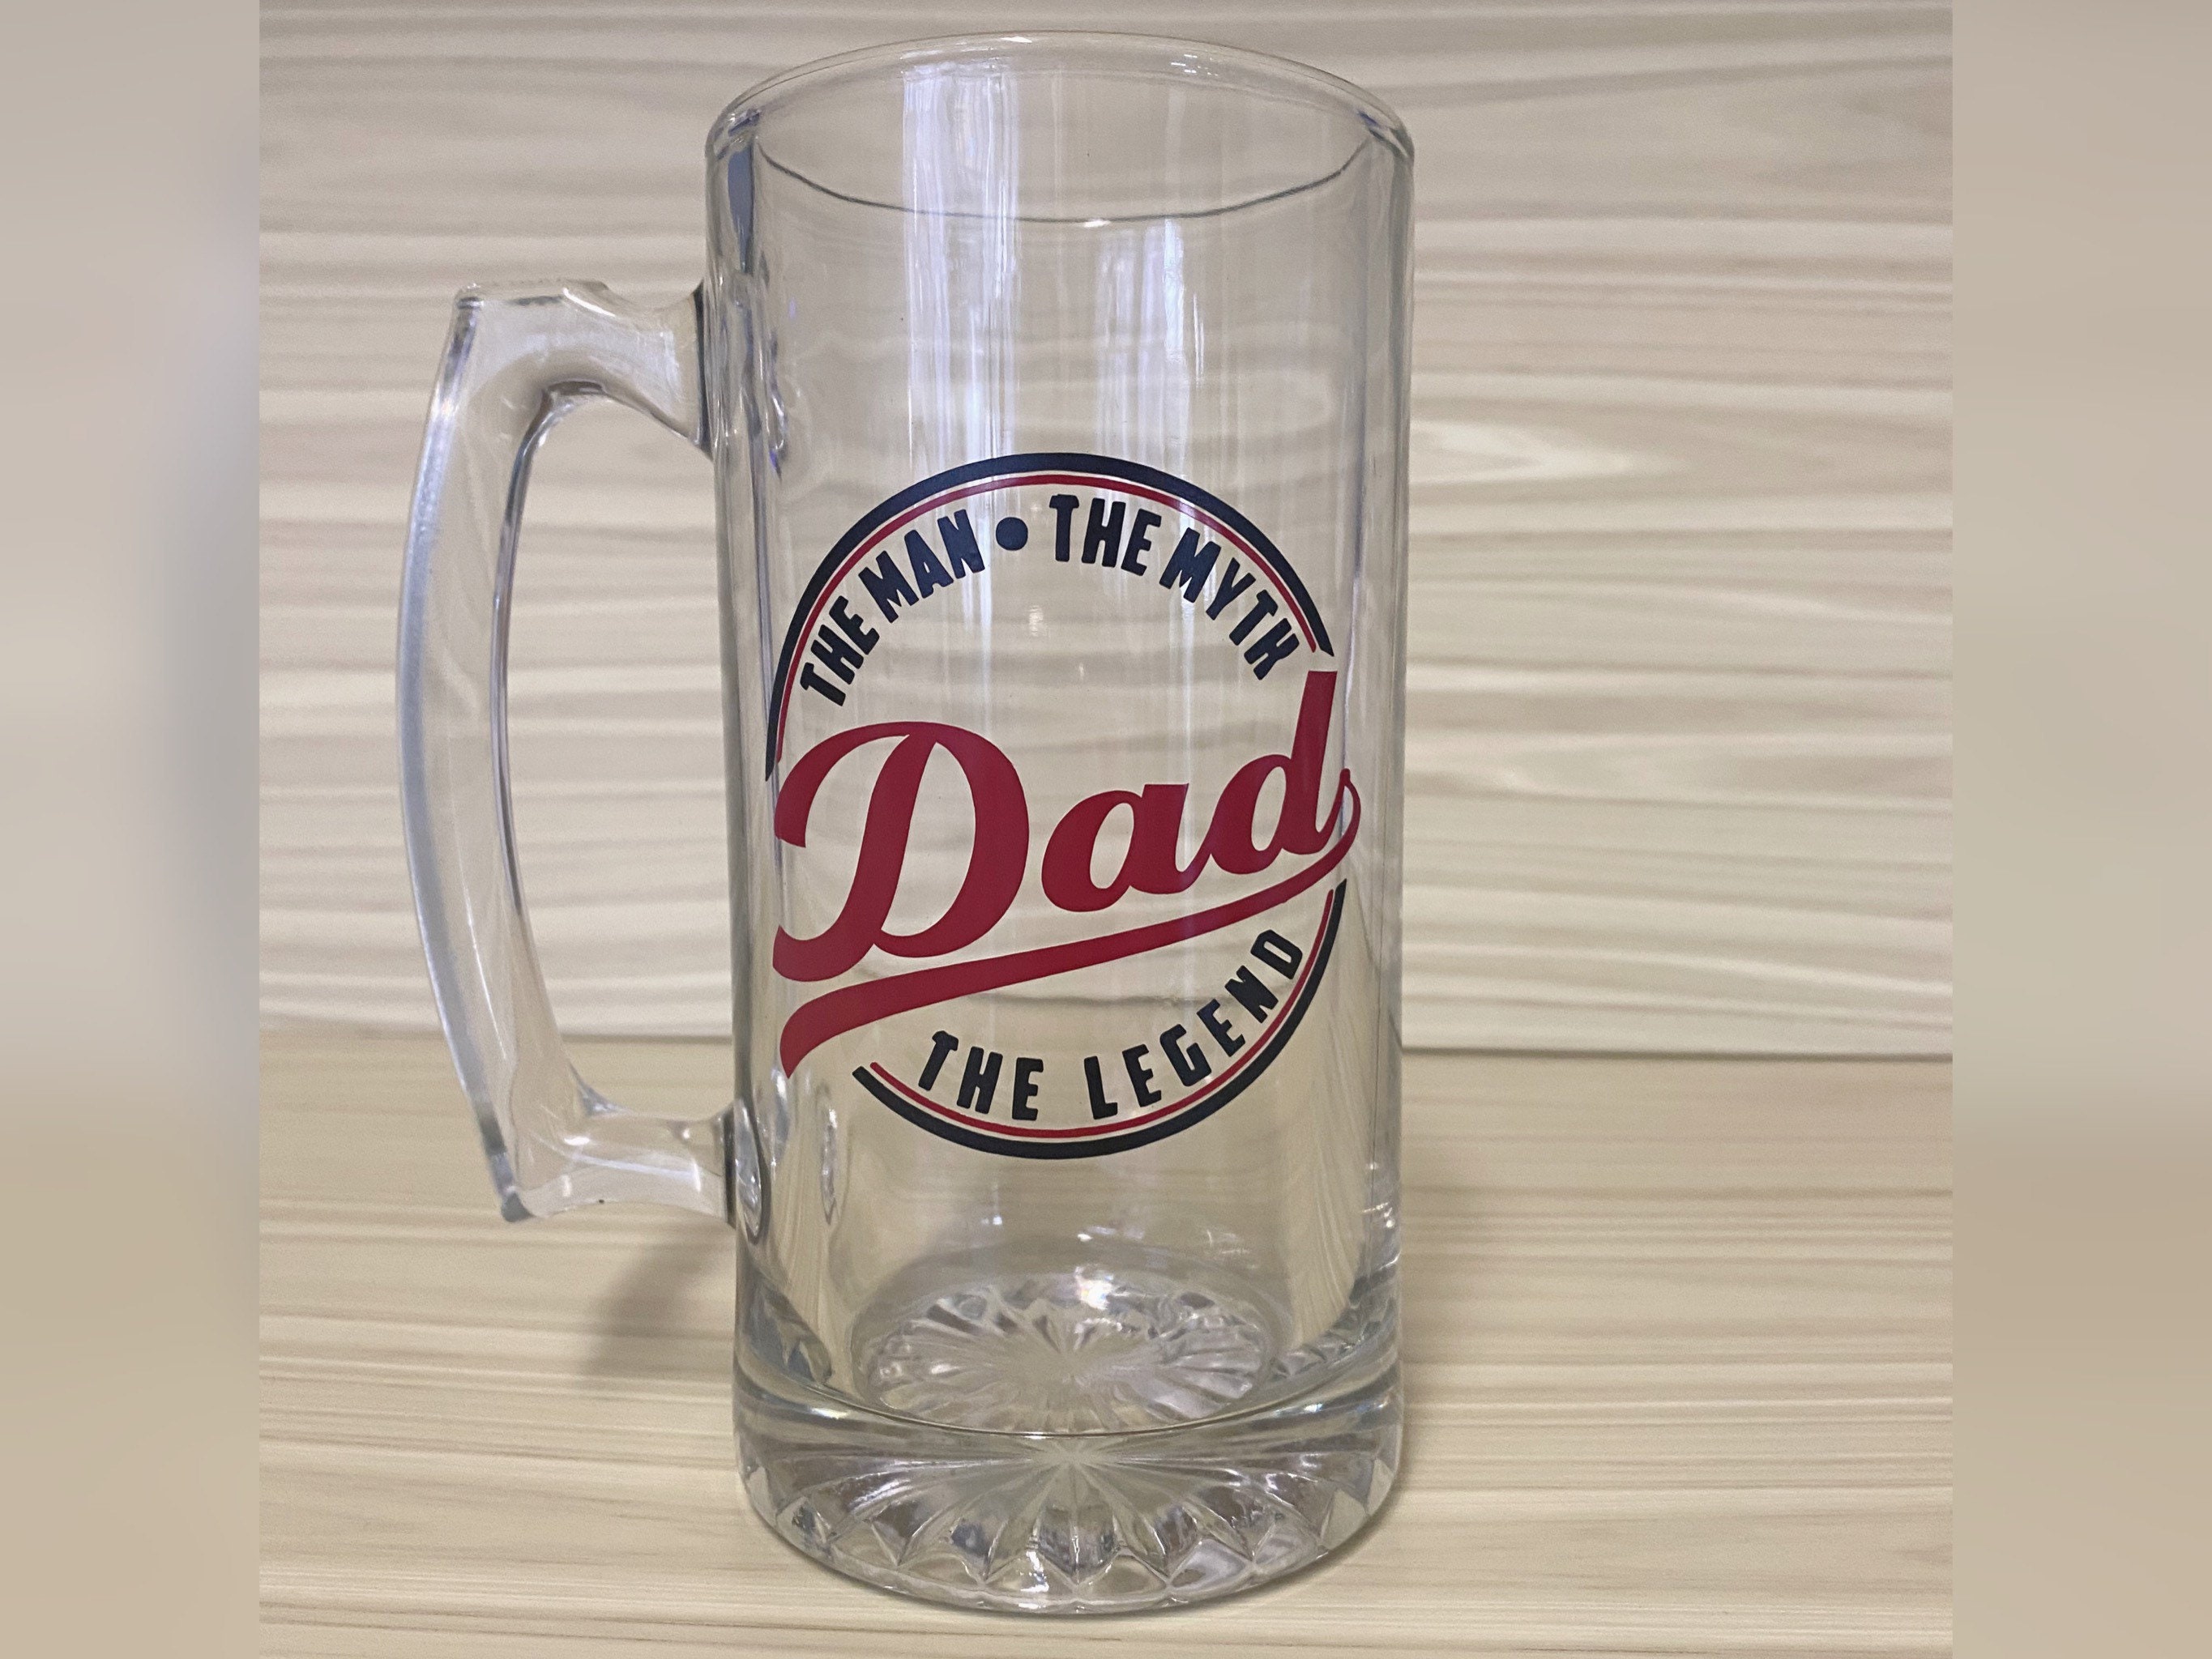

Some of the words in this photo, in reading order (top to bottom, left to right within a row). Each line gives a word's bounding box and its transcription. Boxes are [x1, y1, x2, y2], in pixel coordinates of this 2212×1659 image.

[798, 595, 879, 707] THE
[858, 509, 985, 624] MAN
[1048, 493, 1162, 576] THE
[1159, 527, 1300, 680] MYTH
[772, 671, 1361, 982] Dad
[917, 1030, 1044, 1122] THE
[1083, 929, 1304, 1120] LEGEND
